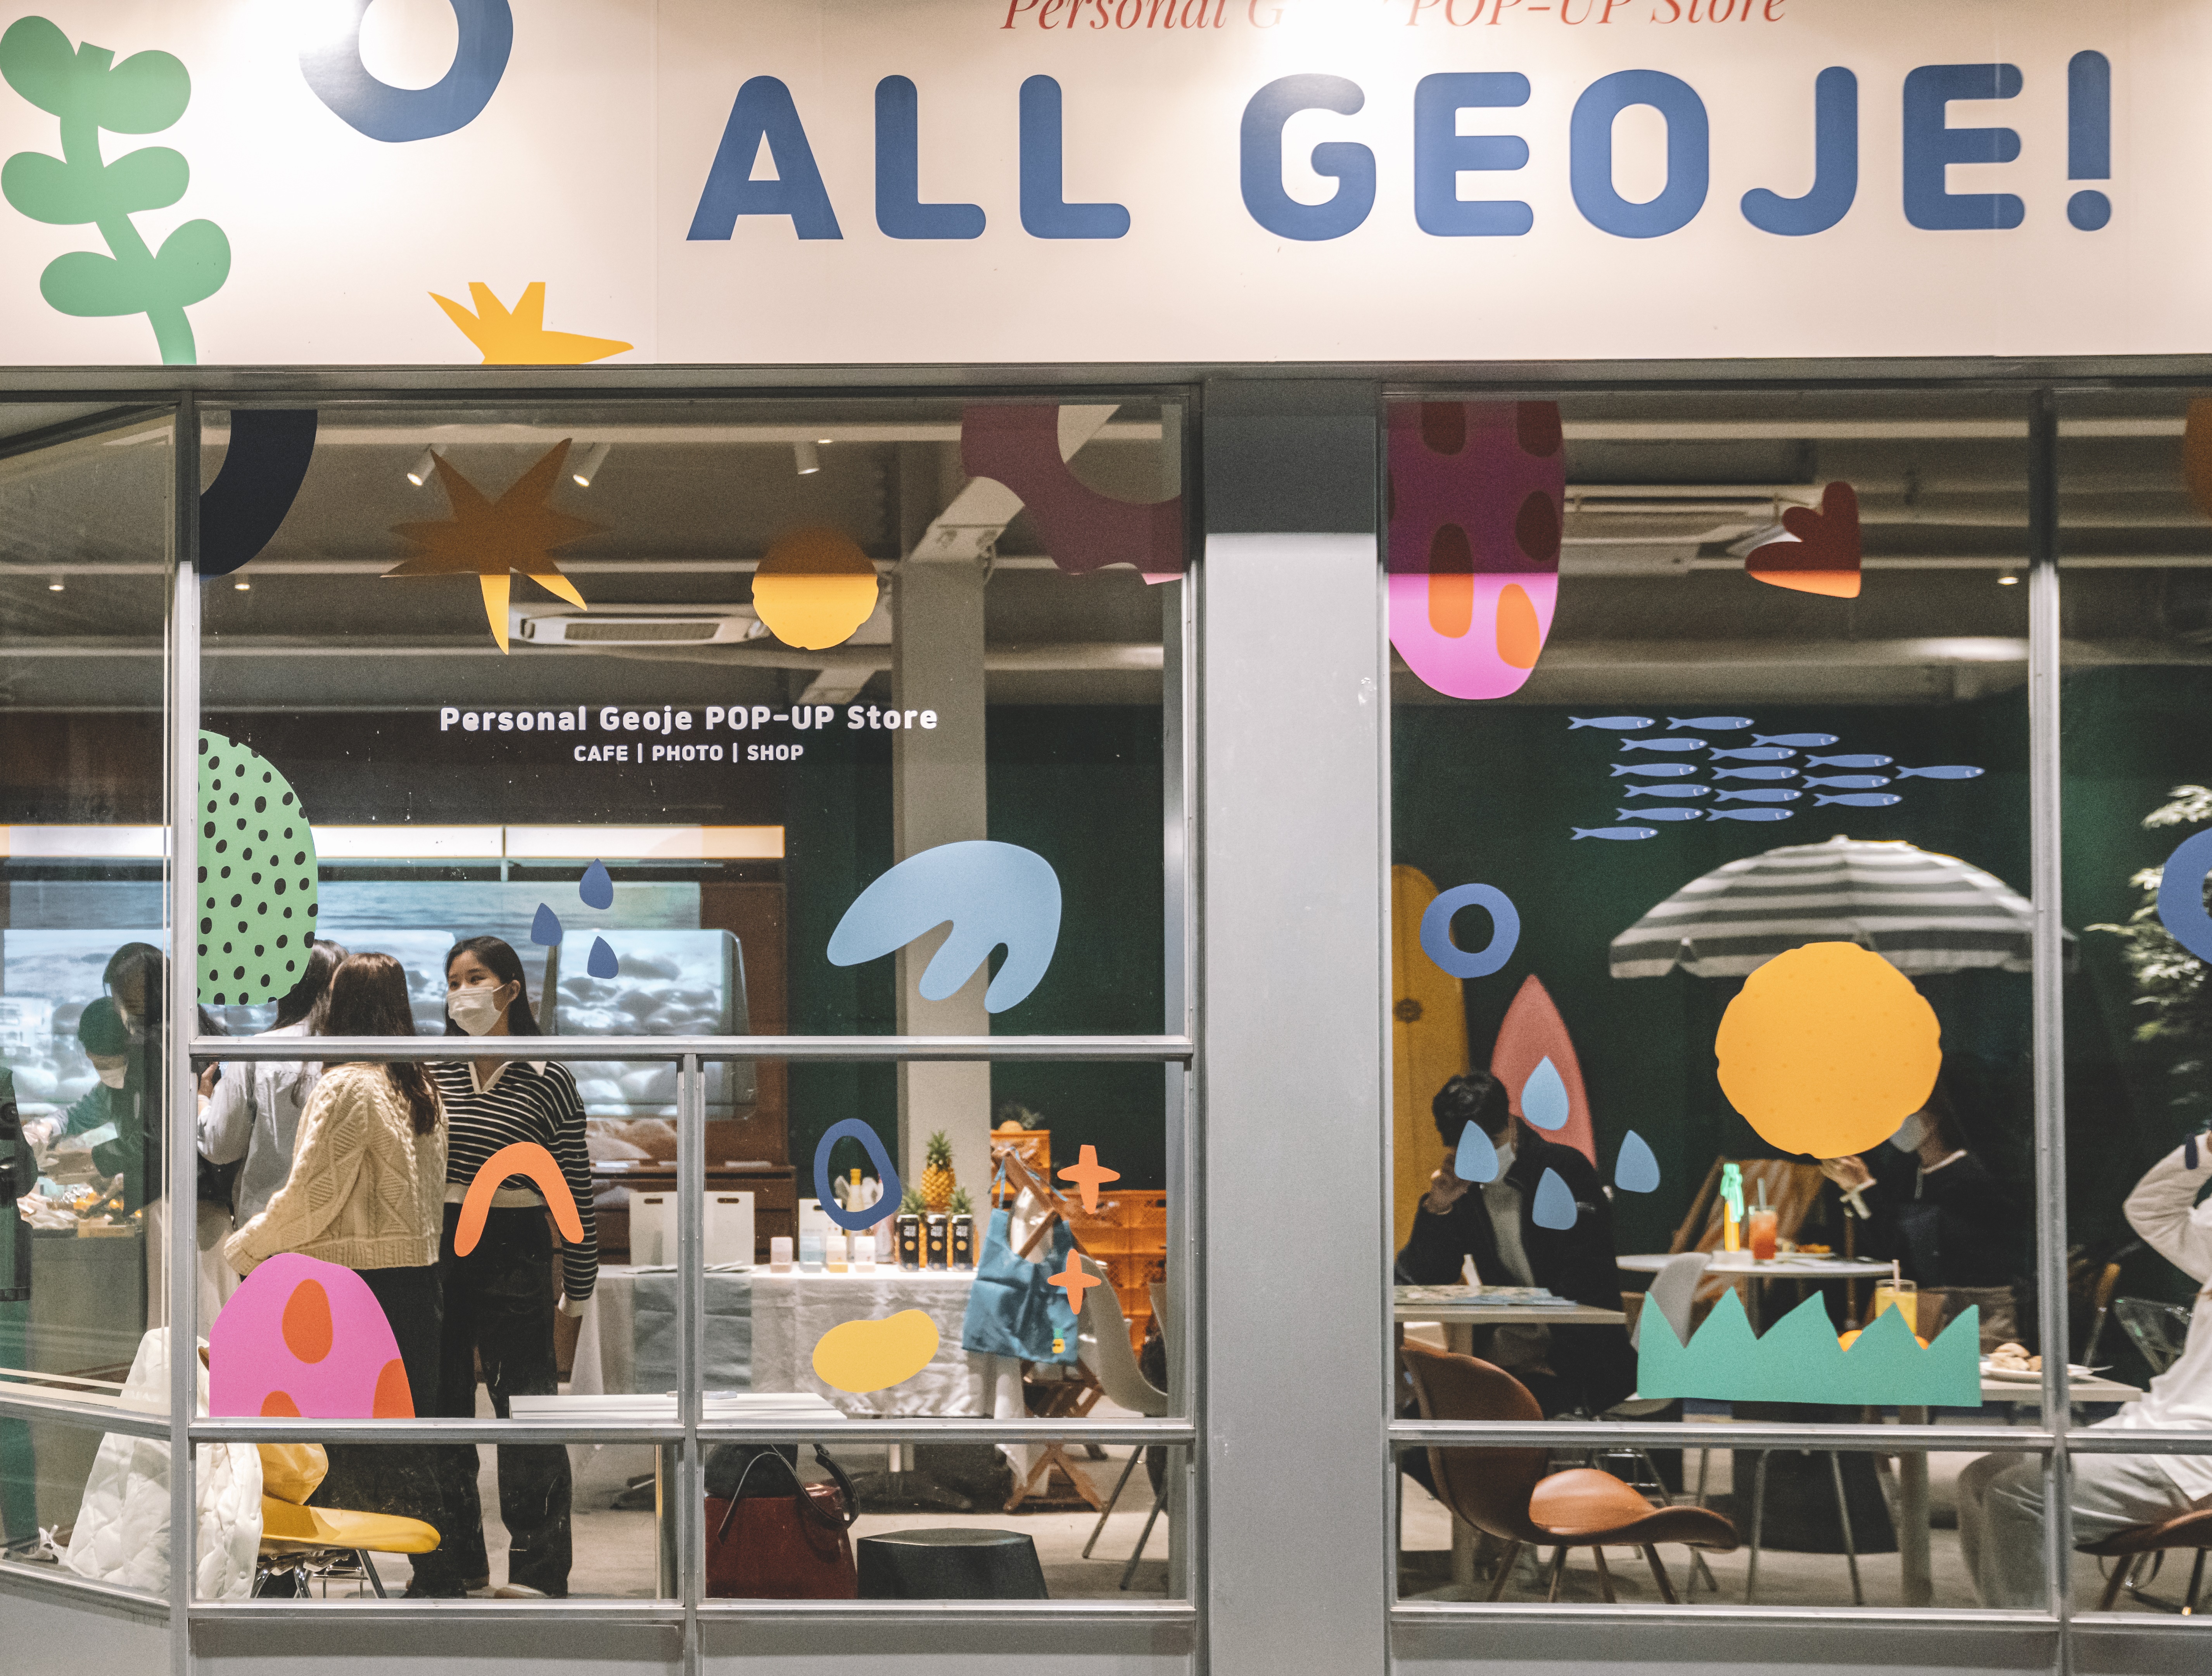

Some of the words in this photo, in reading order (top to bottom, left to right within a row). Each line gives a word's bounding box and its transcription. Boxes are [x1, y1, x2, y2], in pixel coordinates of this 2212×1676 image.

[1000, 0, 1226, 30] Personal
[1649, 0, 1785, 24] Store
[686, 75, 1131, 241] ALL
[1240, 50, 2112, 242] GEOJE!
[441, 706, 586, 731] Personal
[600, 706, 692, 735] Geoje
[706, 706, 834, 730] POP-UP
[847, 706, 938, 730] Store
[574, 745, 628, 761] CAFE
[652, 745, 723, 761] PHOTO
[747, 745, 804, 761] SHOP
